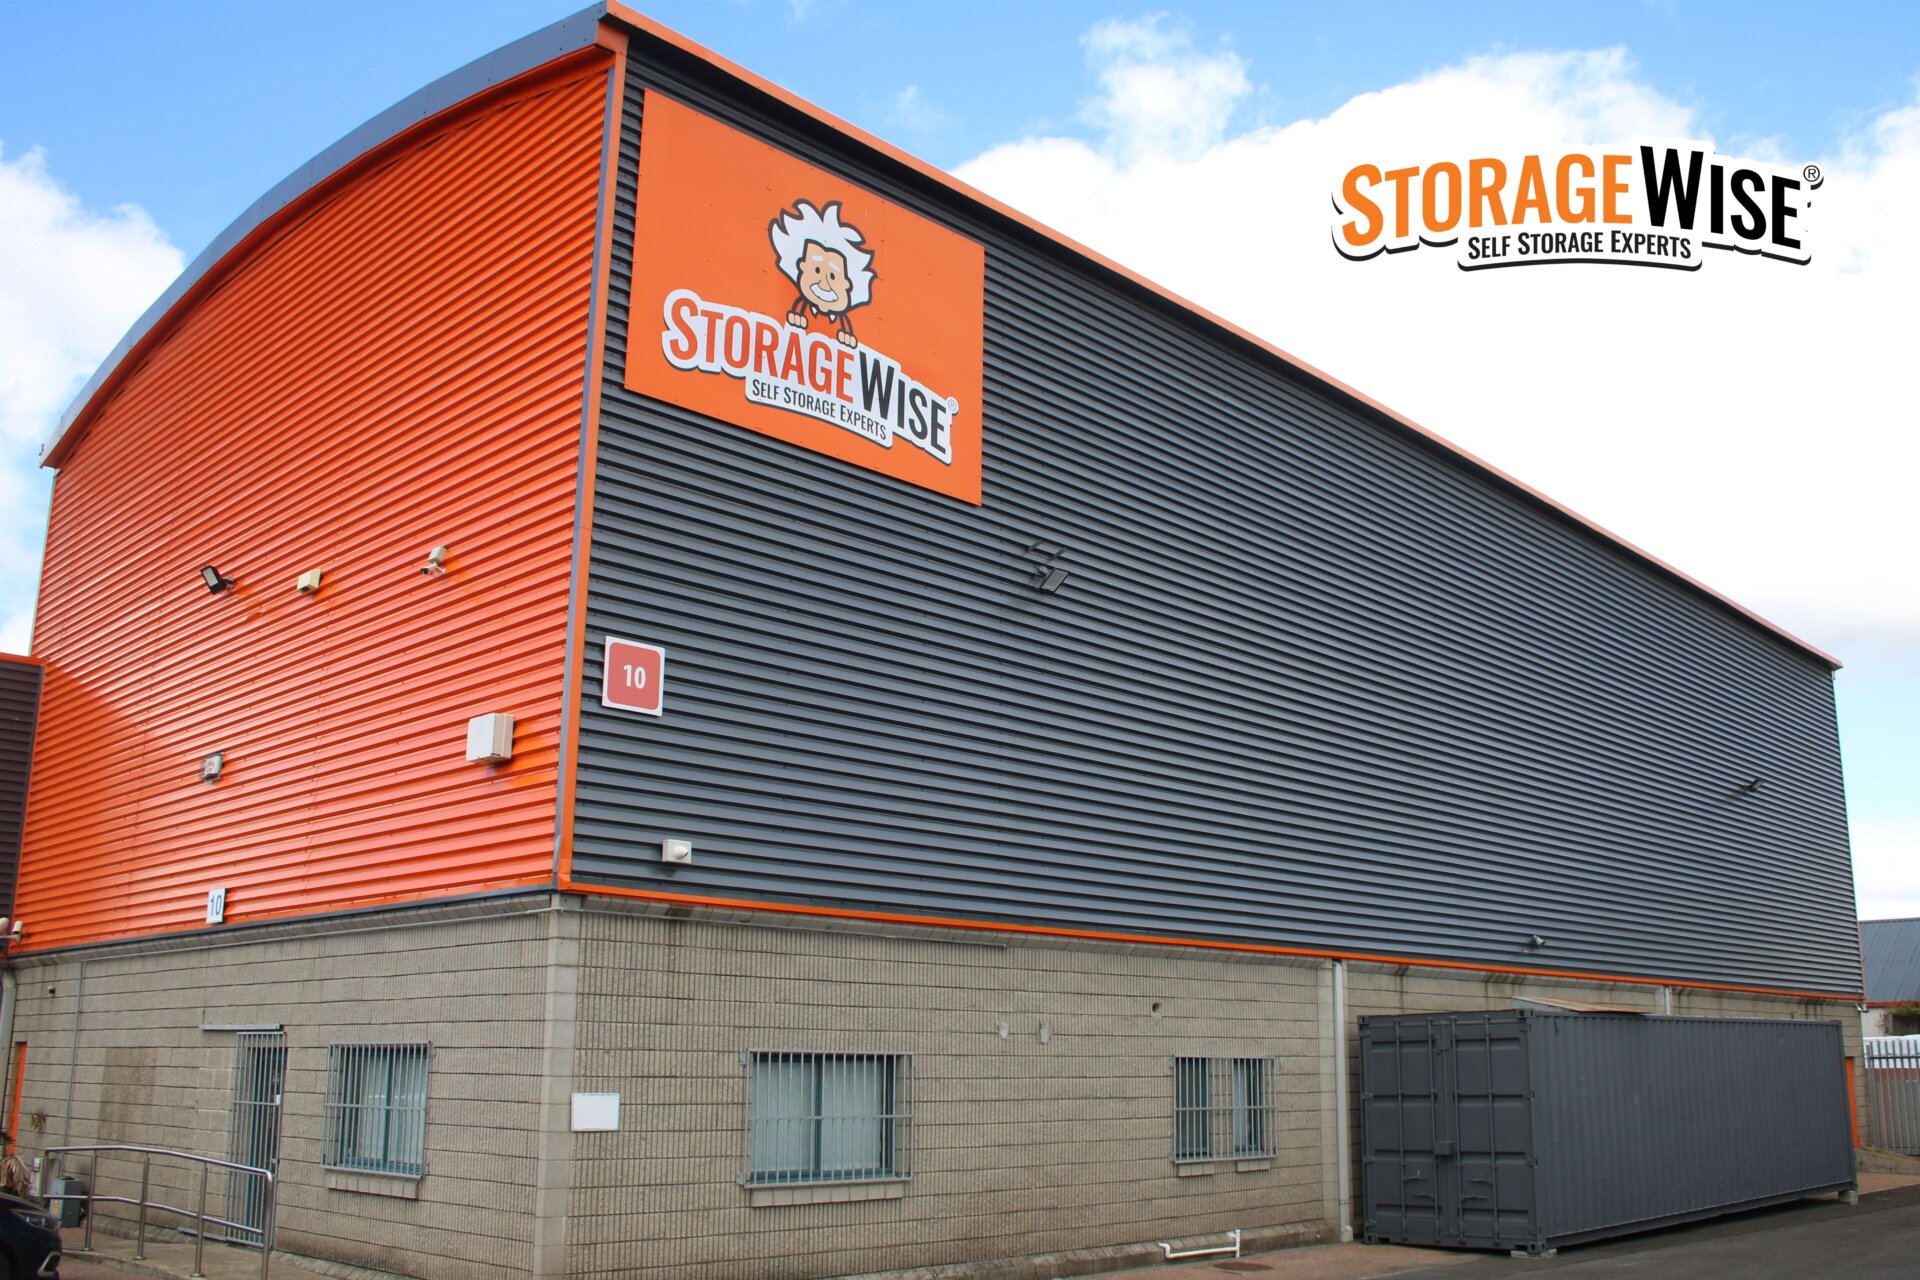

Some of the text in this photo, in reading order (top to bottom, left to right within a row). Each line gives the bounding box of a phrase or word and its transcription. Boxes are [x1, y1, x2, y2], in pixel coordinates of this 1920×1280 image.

[752, 379, 886, 440] SELF STORAGE EXPERTS
[623, 664, 646, 689] 10
[210, 894, 222, 916] 10
